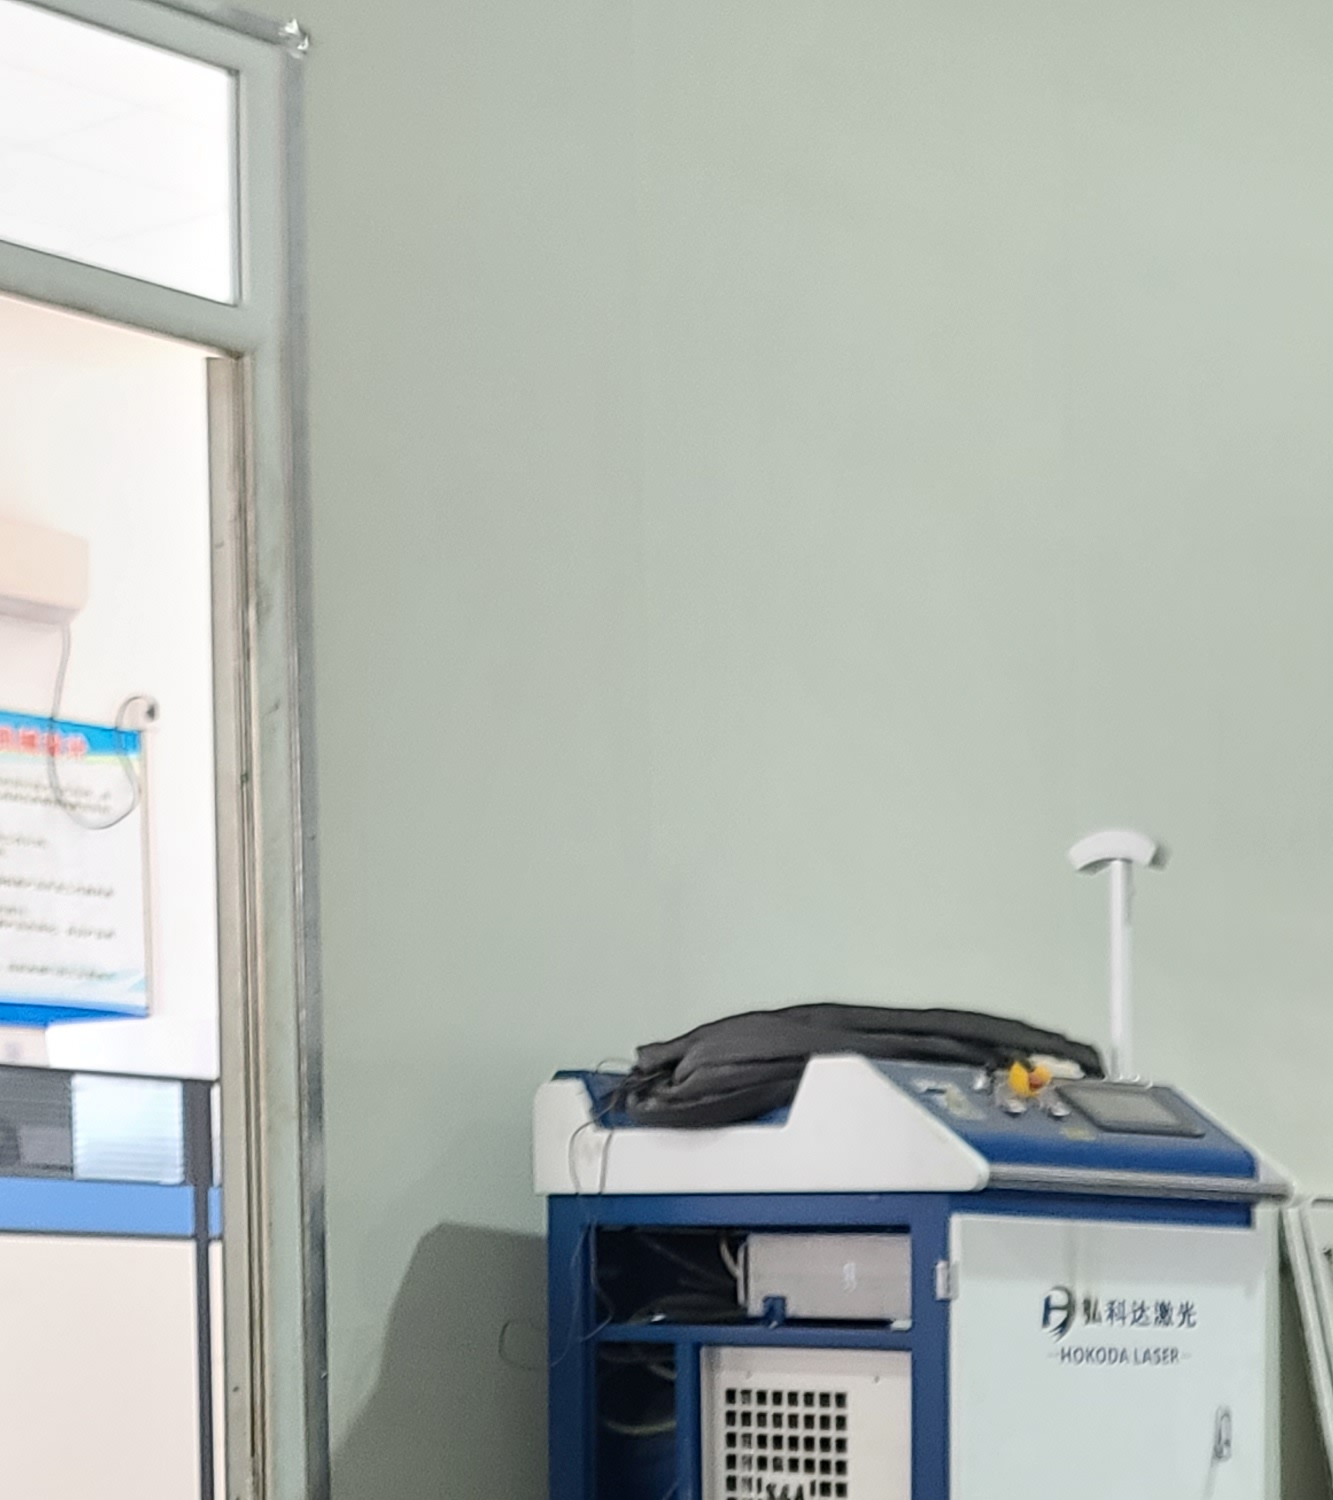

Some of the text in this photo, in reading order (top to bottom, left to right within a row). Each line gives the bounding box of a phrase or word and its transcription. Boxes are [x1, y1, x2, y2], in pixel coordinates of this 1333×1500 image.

[1082, 1298, 1198, 1328] 弘科达激光
[1060, 1346, 1180, 1366] HOKODA LASER
